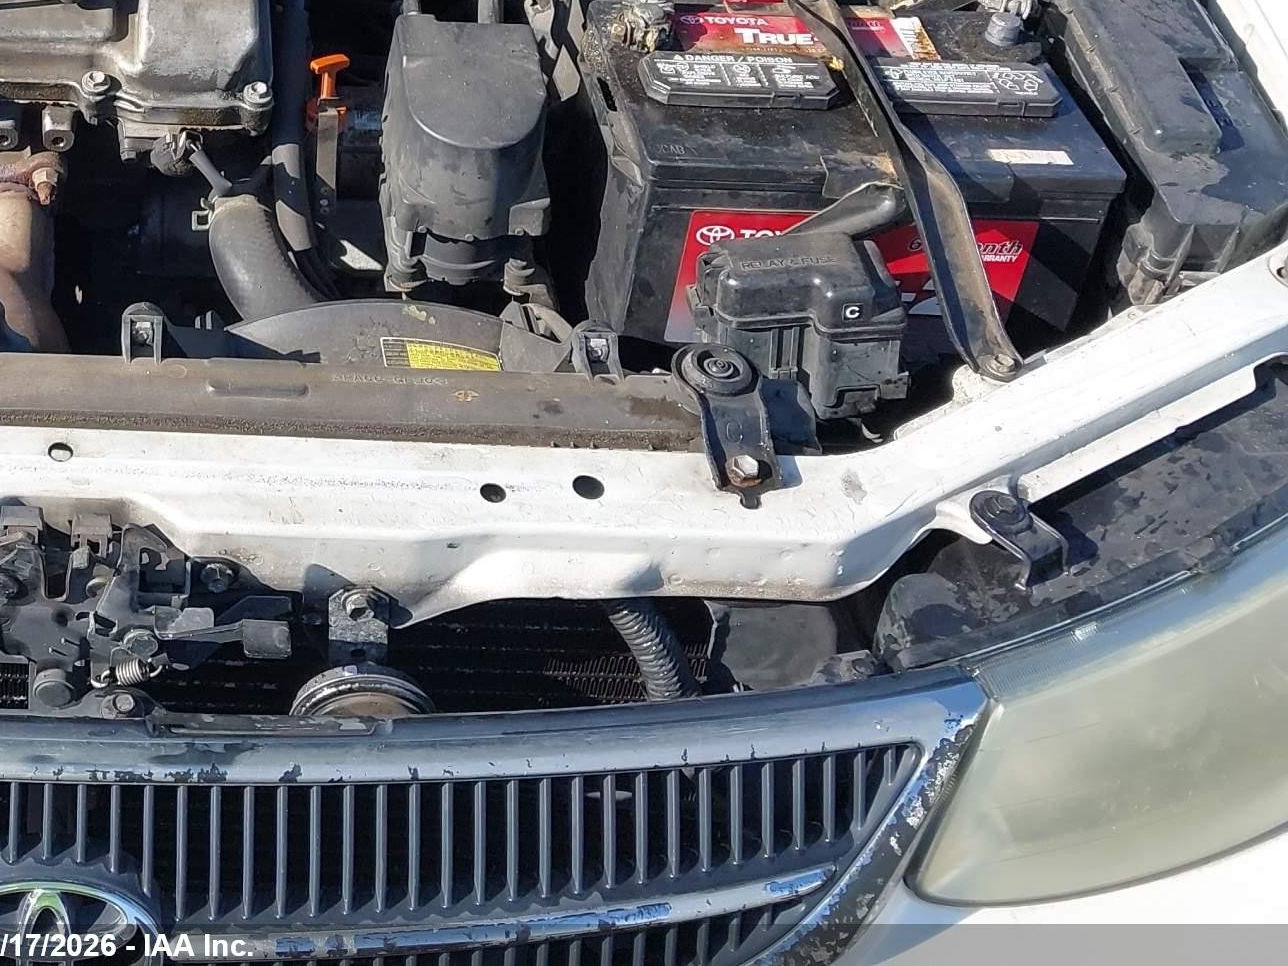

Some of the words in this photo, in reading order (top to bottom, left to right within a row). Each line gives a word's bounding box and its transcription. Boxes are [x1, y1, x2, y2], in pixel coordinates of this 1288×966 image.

[704, 16, 769, 26] TOYOTA
[733, 27, 819, 46] TRUE
[684, 54, 735, 63] DANGER
[747, 55, 793, 64] POISON
[740, 257, 785, 271] RELAY
[845, 306, 860, 319] C
